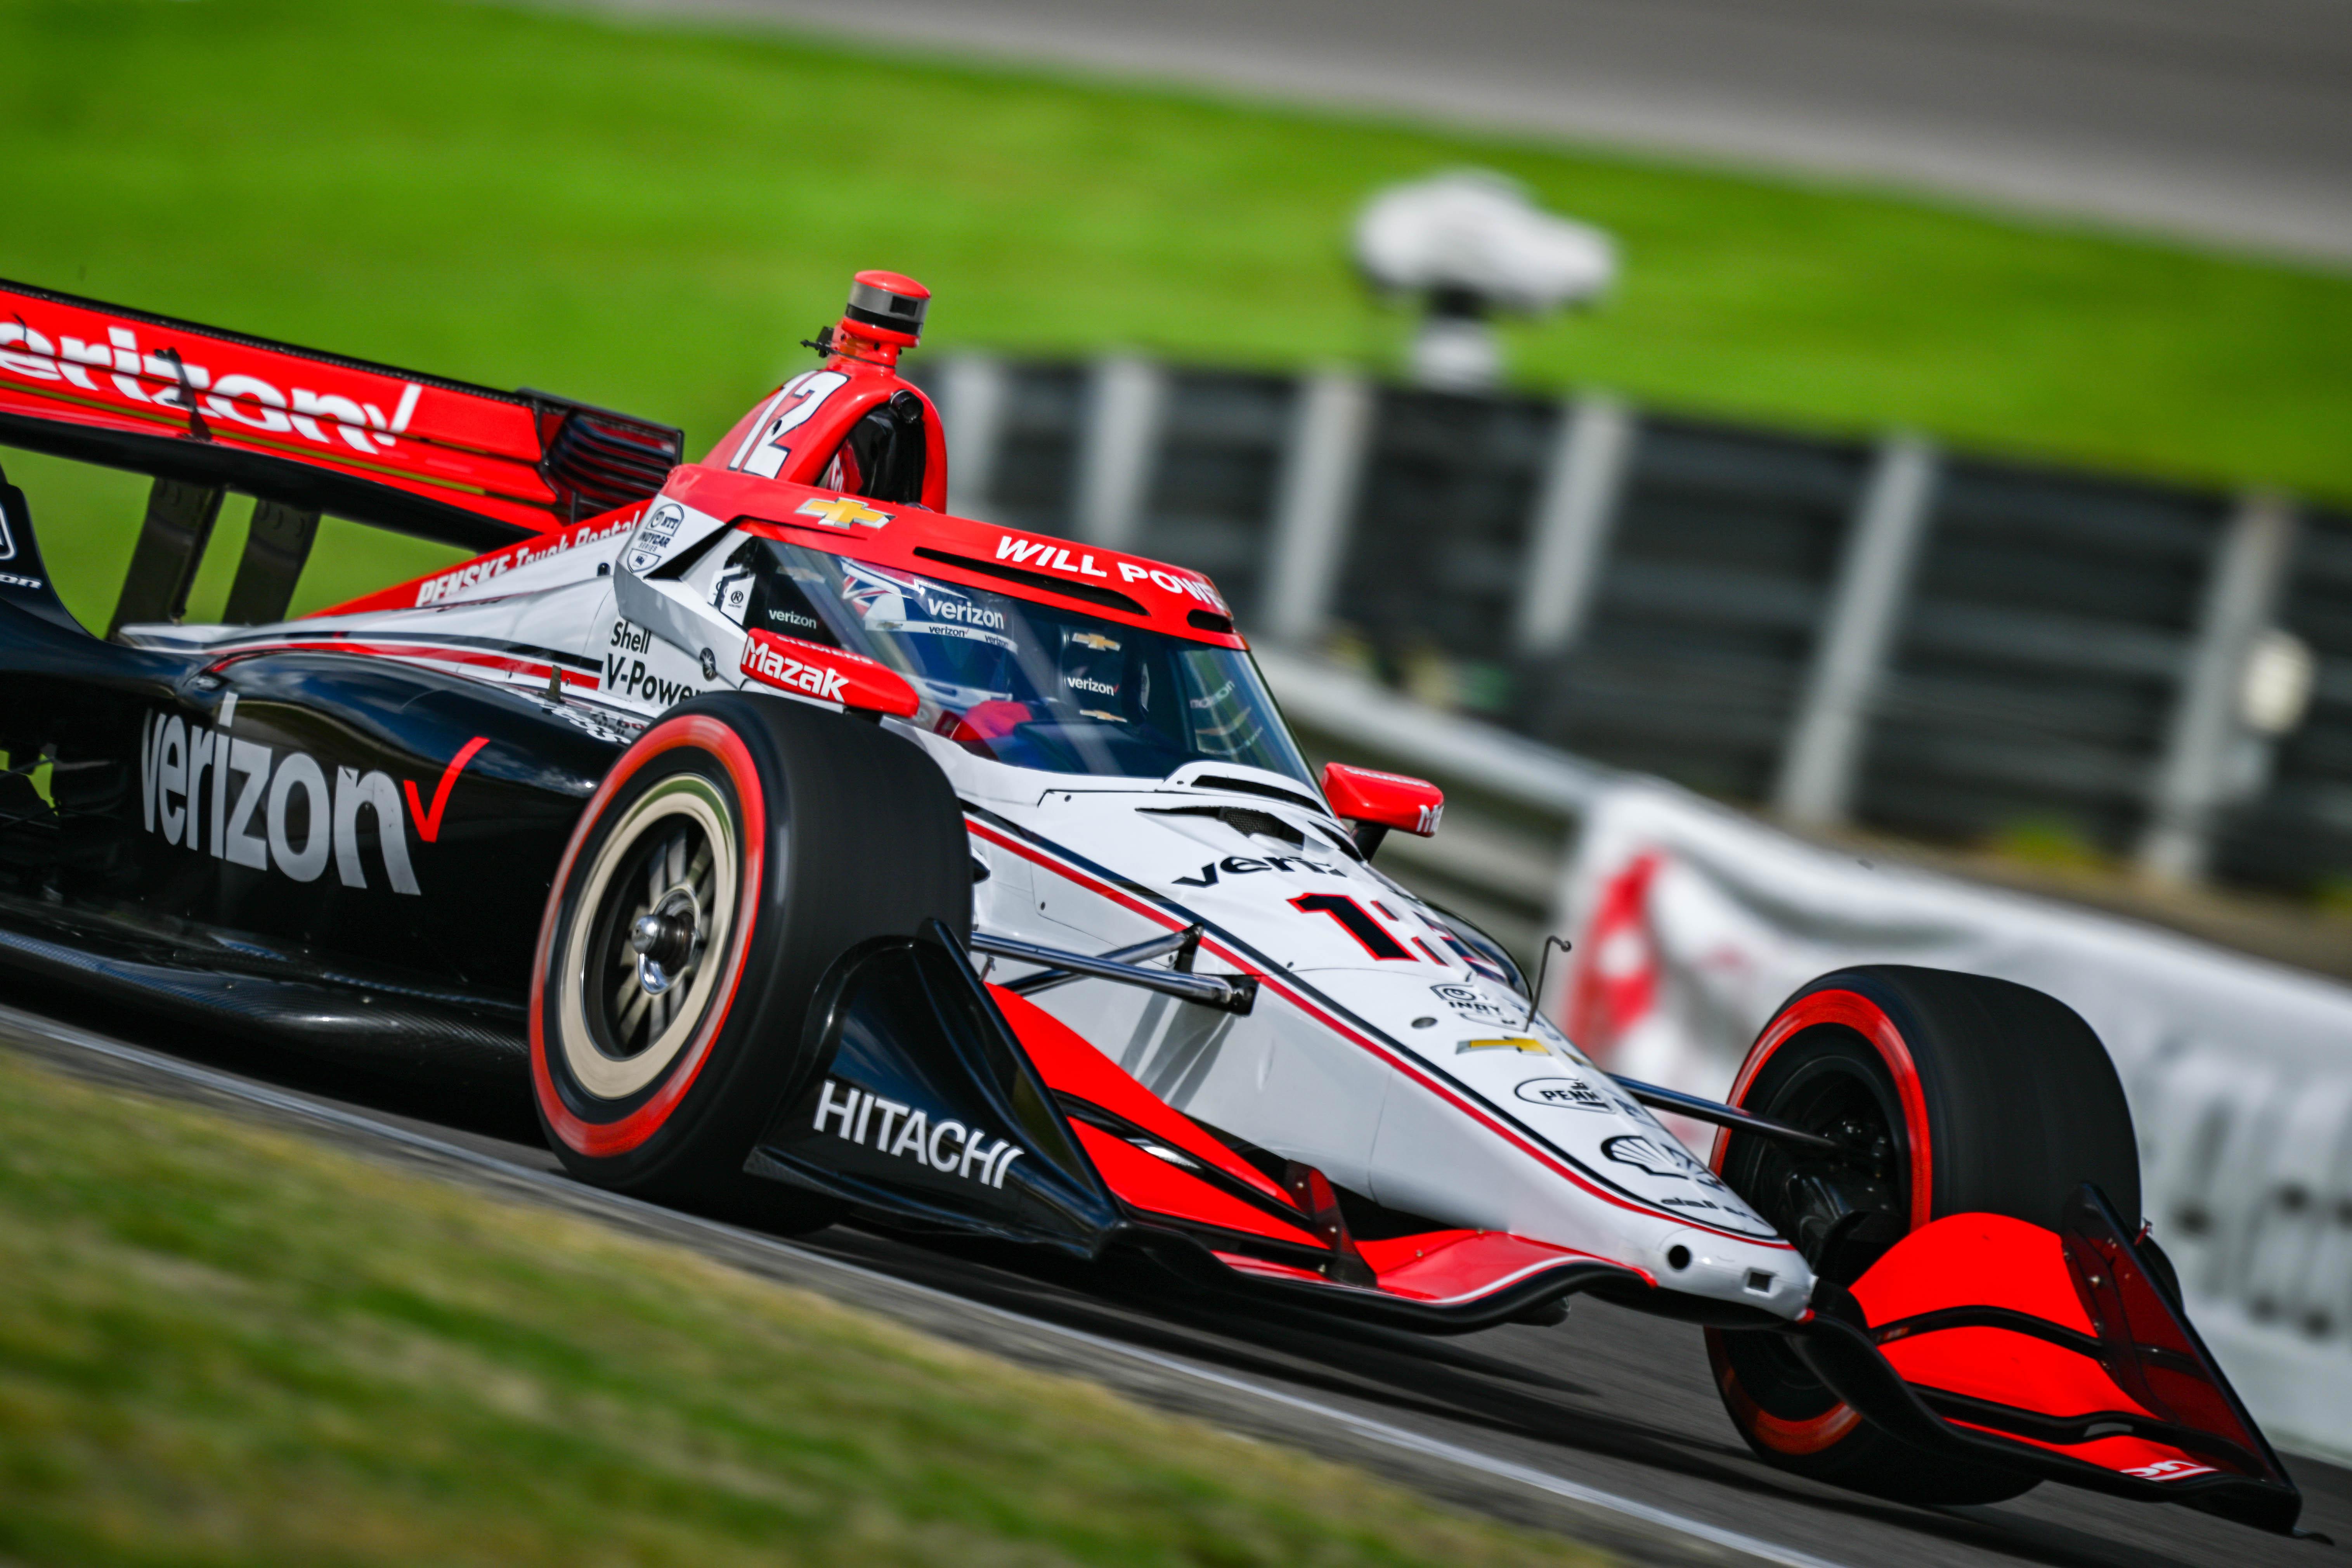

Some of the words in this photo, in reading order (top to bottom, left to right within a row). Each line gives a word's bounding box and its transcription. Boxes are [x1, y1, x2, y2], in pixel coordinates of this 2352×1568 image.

[727, 370, 851, 479] 12
[661, 516, 679, 529] NTT
[996, 536, 1107, 577] WILL
[415, 554, 511, 608] PENSKE
[769, 609, 817, 629] verizon
[928, 598, 1004, 630] verizon
[929, 625, 965, 637] verizon
[610, 621, 652, 655] Shell
[742, 636, 849, 703] Mazak
[1067, 677, 1114, 696] verizon
[142, 691, 421, 896] verizon
[813, 1080, 1024, 1189] HITACHI
